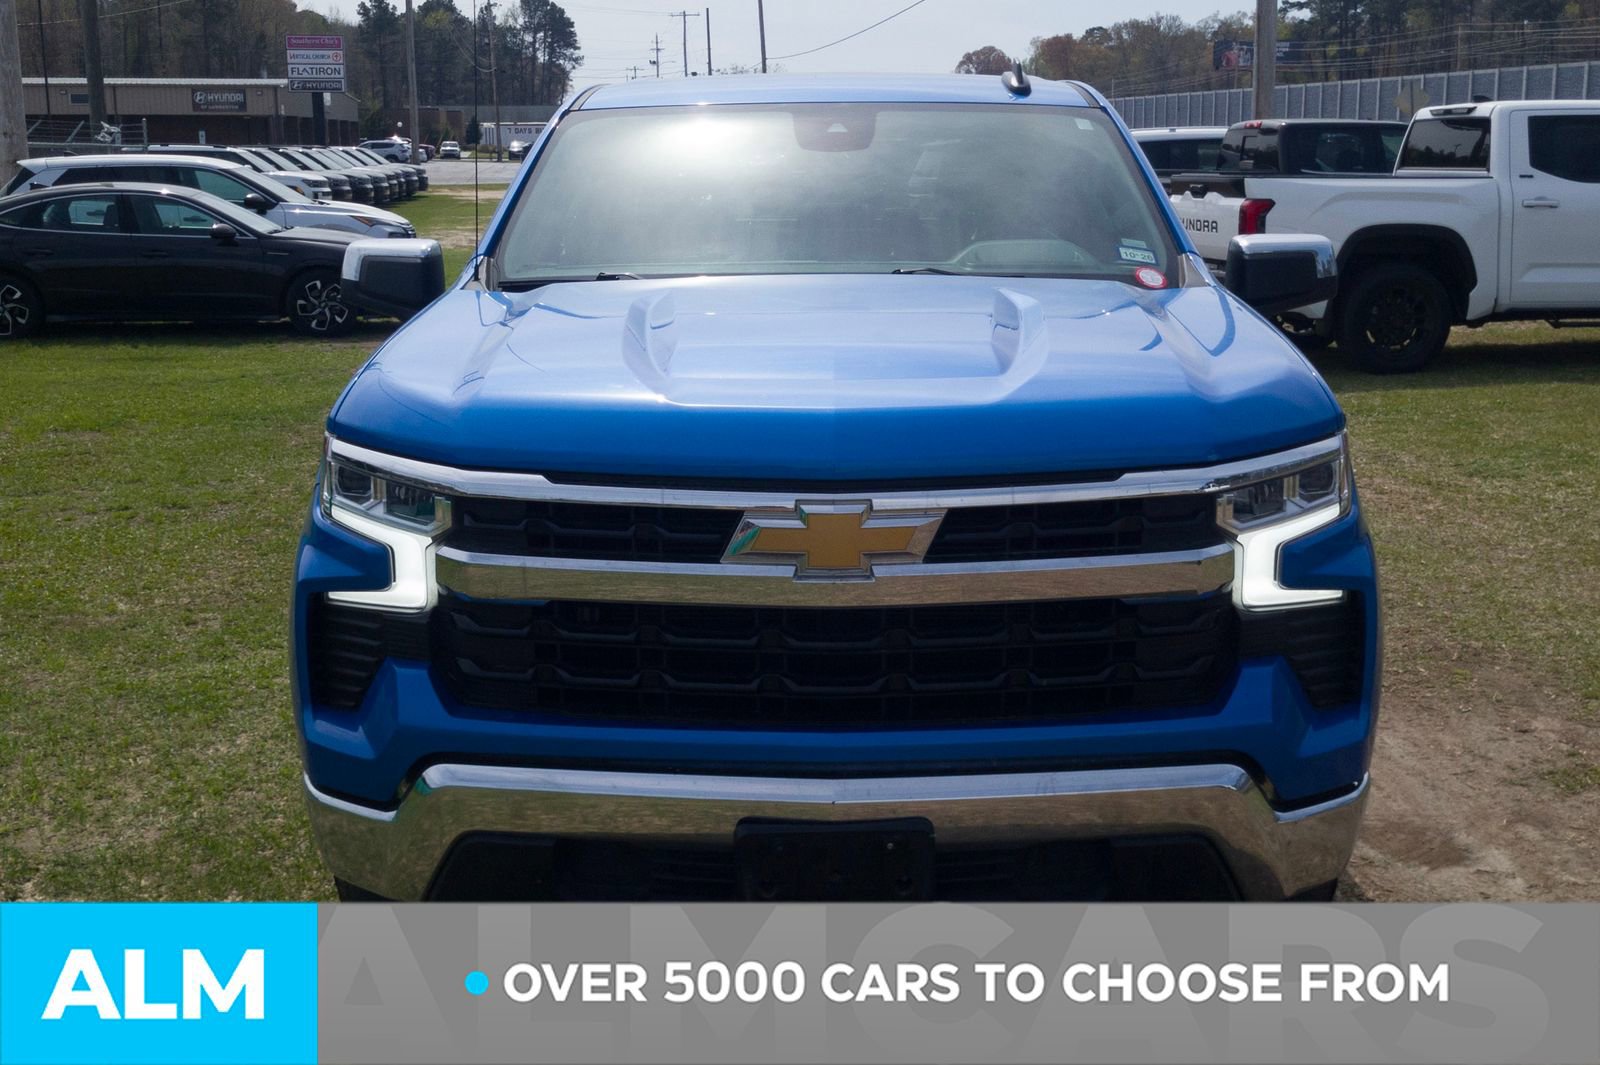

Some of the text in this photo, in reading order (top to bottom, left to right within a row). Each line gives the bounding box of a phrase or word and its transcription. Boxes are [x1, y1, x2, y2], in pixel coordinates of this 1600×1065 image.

[290, 66, 341, 76] FLATIRON
[207, 92, 244, 103] HYUNDAI
[1180, 216, 1219, 233] UNDRA
